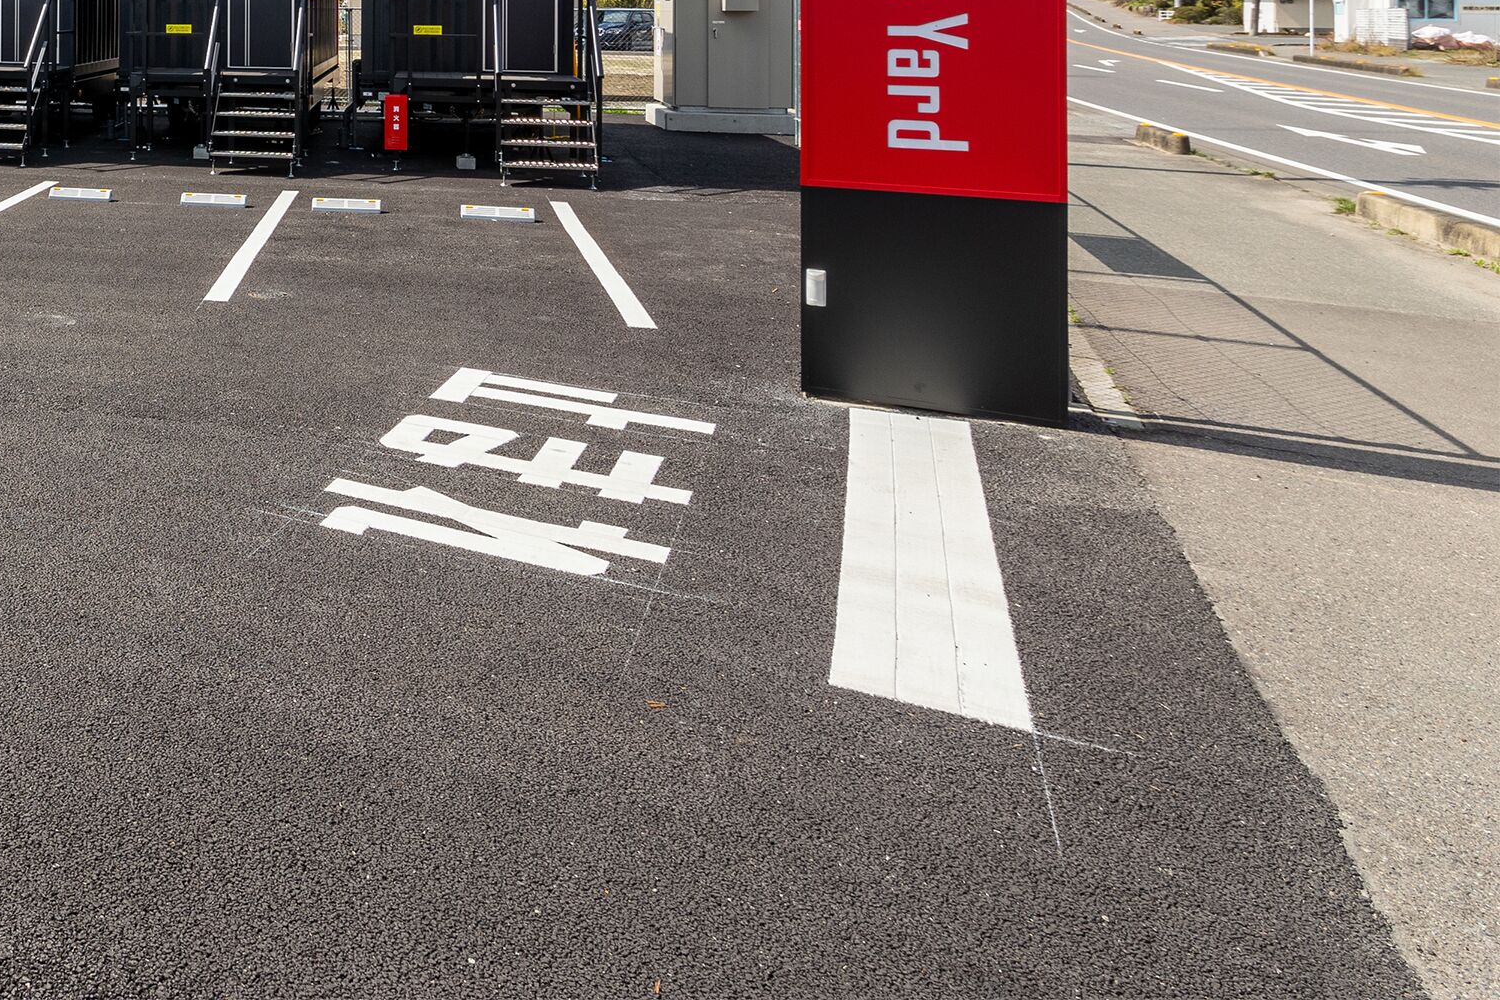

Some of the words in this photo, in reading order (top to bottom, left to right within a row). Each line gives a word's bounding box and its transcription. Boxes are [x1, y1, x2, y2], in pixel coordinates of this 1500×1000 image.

[886, 12, 970, 153] Yard
[320, 367, 717, 577] 止まれ
